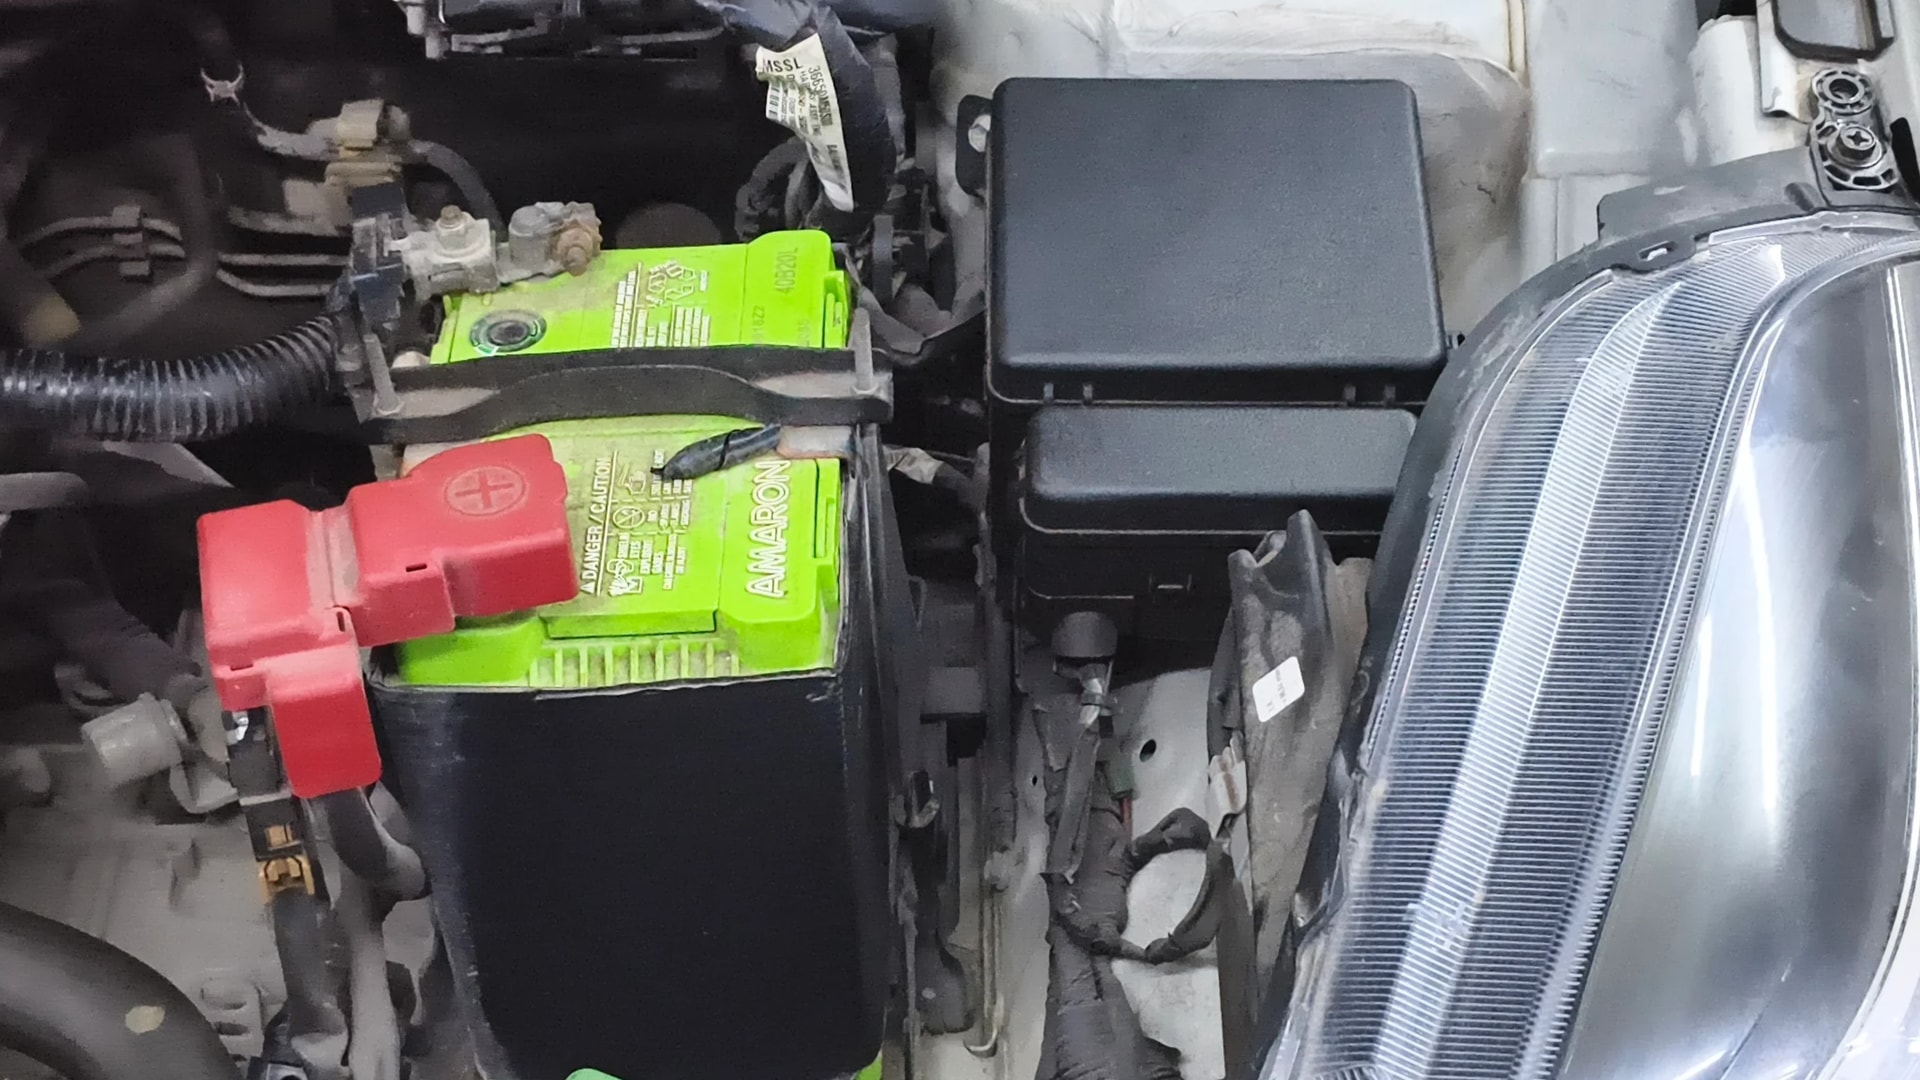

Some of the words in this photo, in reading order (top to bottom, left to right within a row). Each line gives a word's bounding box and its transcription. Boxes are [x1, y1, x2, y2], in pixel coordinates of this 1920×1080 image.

[762, 57, 804, 73] MSSL
[774, 247, 798, 295] 40B20L
[590, 457, 610, 514] CAUTION
[581, 525, 603, 580] DANGER
[744, 459, 791, 598] AMARON
